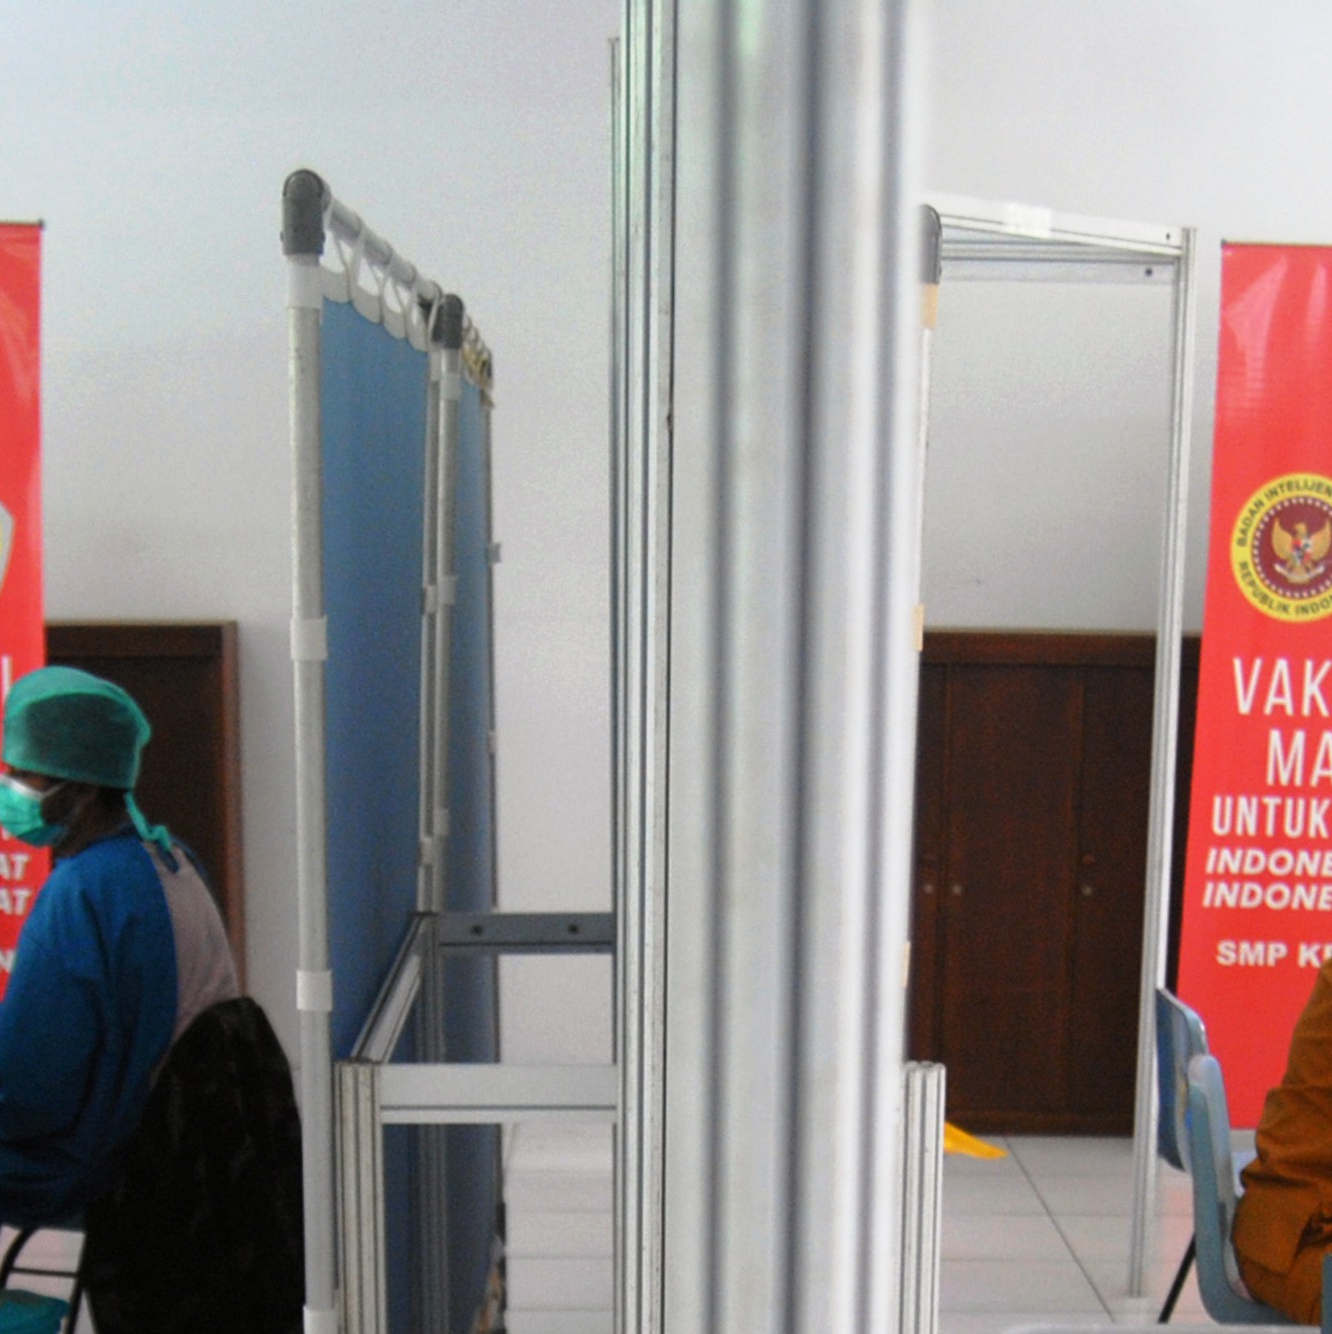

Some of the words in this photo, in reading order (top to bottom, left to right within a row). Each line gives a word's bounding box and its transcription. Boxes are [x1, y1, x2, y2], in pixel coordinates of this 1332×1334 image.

[1236, 499, 1265, 547] BADAN
[1239, 561, 1290, 614] REPUBLIK
[1211, 795, 1331, 839] UNTUK
[1216, 940, 1288, 967] SMP
